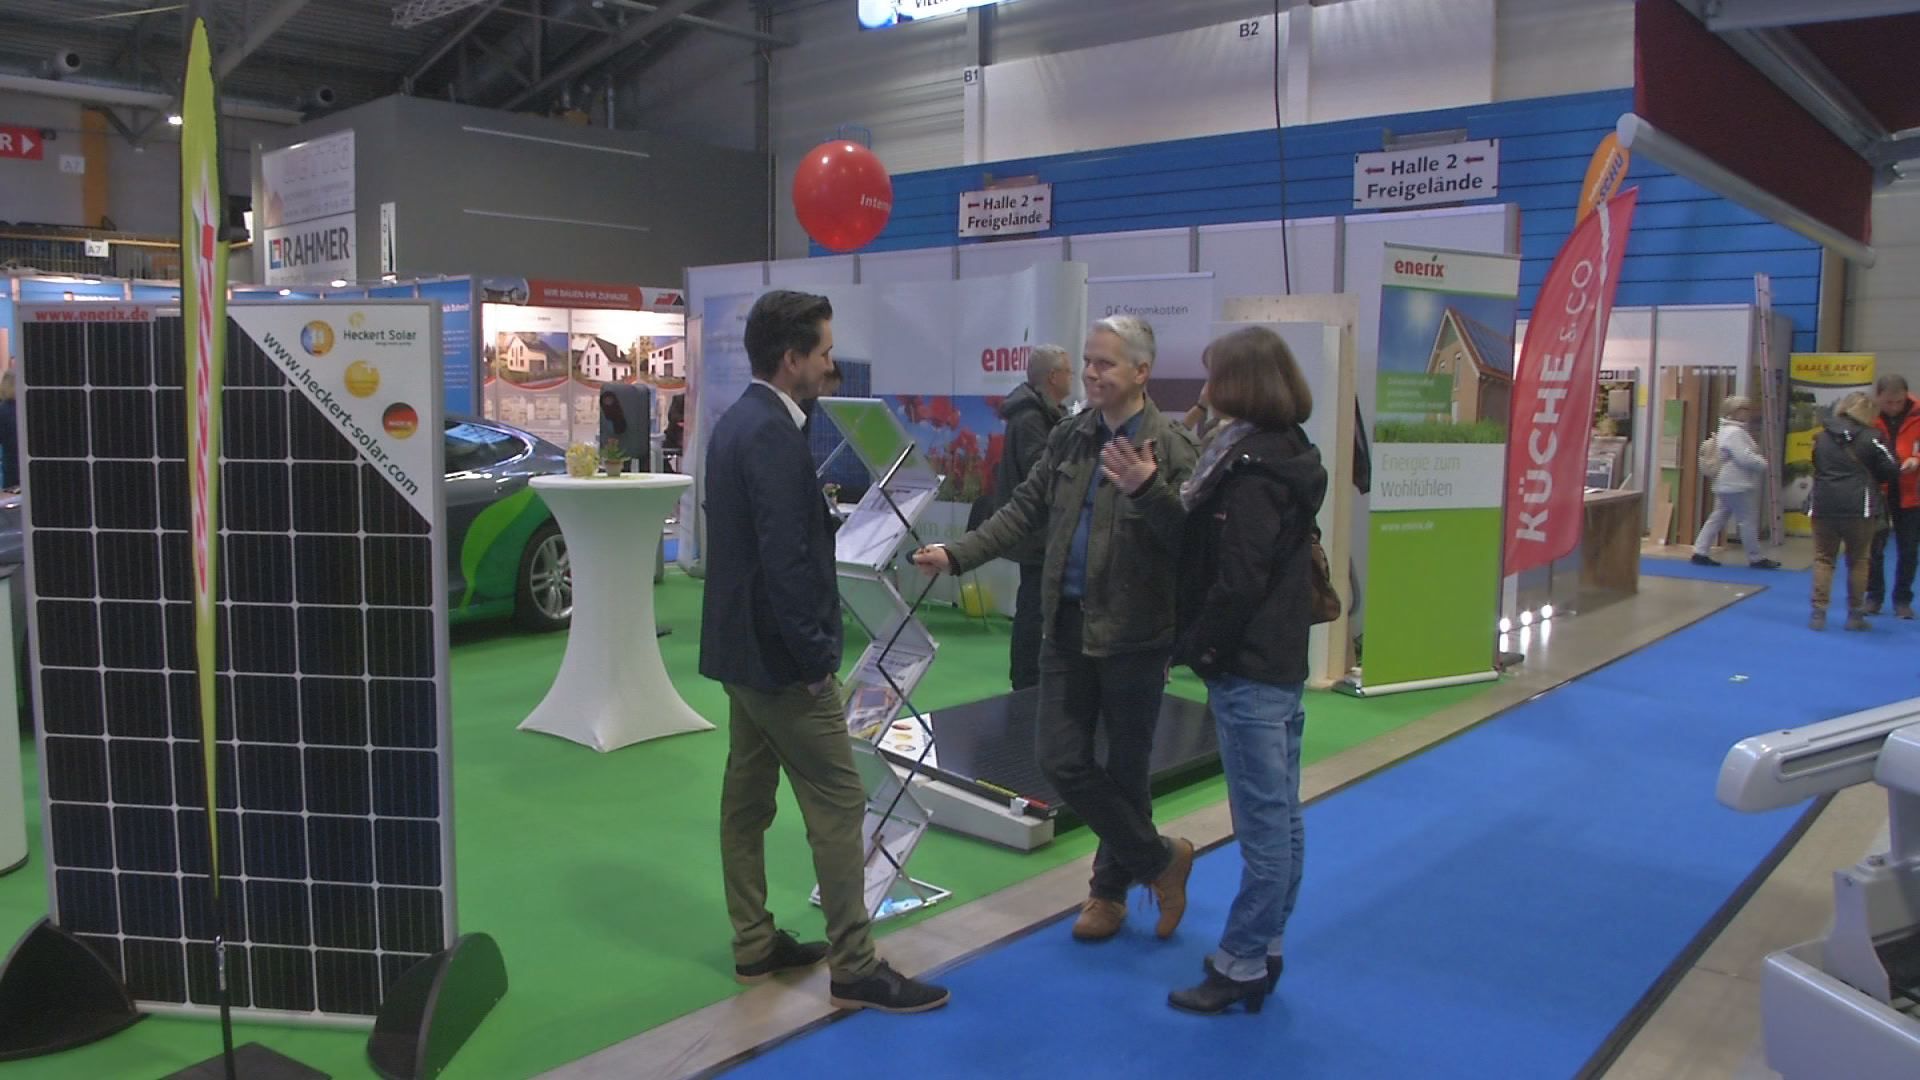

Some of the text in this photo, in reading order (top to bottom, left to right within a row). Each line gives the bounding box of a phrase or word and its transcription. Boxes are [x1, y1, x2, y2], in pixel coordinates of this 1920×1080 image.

[1239, 21, 1259, 37] B2
[963, 69, 979, 83] B1
[1391, 153, 1458, 176] Halle 2
[1367, 173, 1484, 201] Freigelände
[983, 194, 1030, 210] Halle 2
[967, 209, 1043, 231] Freigelände
[86, 245, 103, 255] A7
[283, 226, 350, 268] RAHMER
[1394, 254, 1445, 278] enerix
[35, 306, 149, 321] www.enerix.de
[343, 329, 417, 341] Heckert Solar
[1515, 352, 1575, 543] KÜCHE
[1566, 259, 1593, 315] CO
[263, 332, 419, 496] www.heckert-solar.com
[1381, 453, 1461, 475] Energie zum
[1380, 478, 1453, 497] Wohlfühlen
